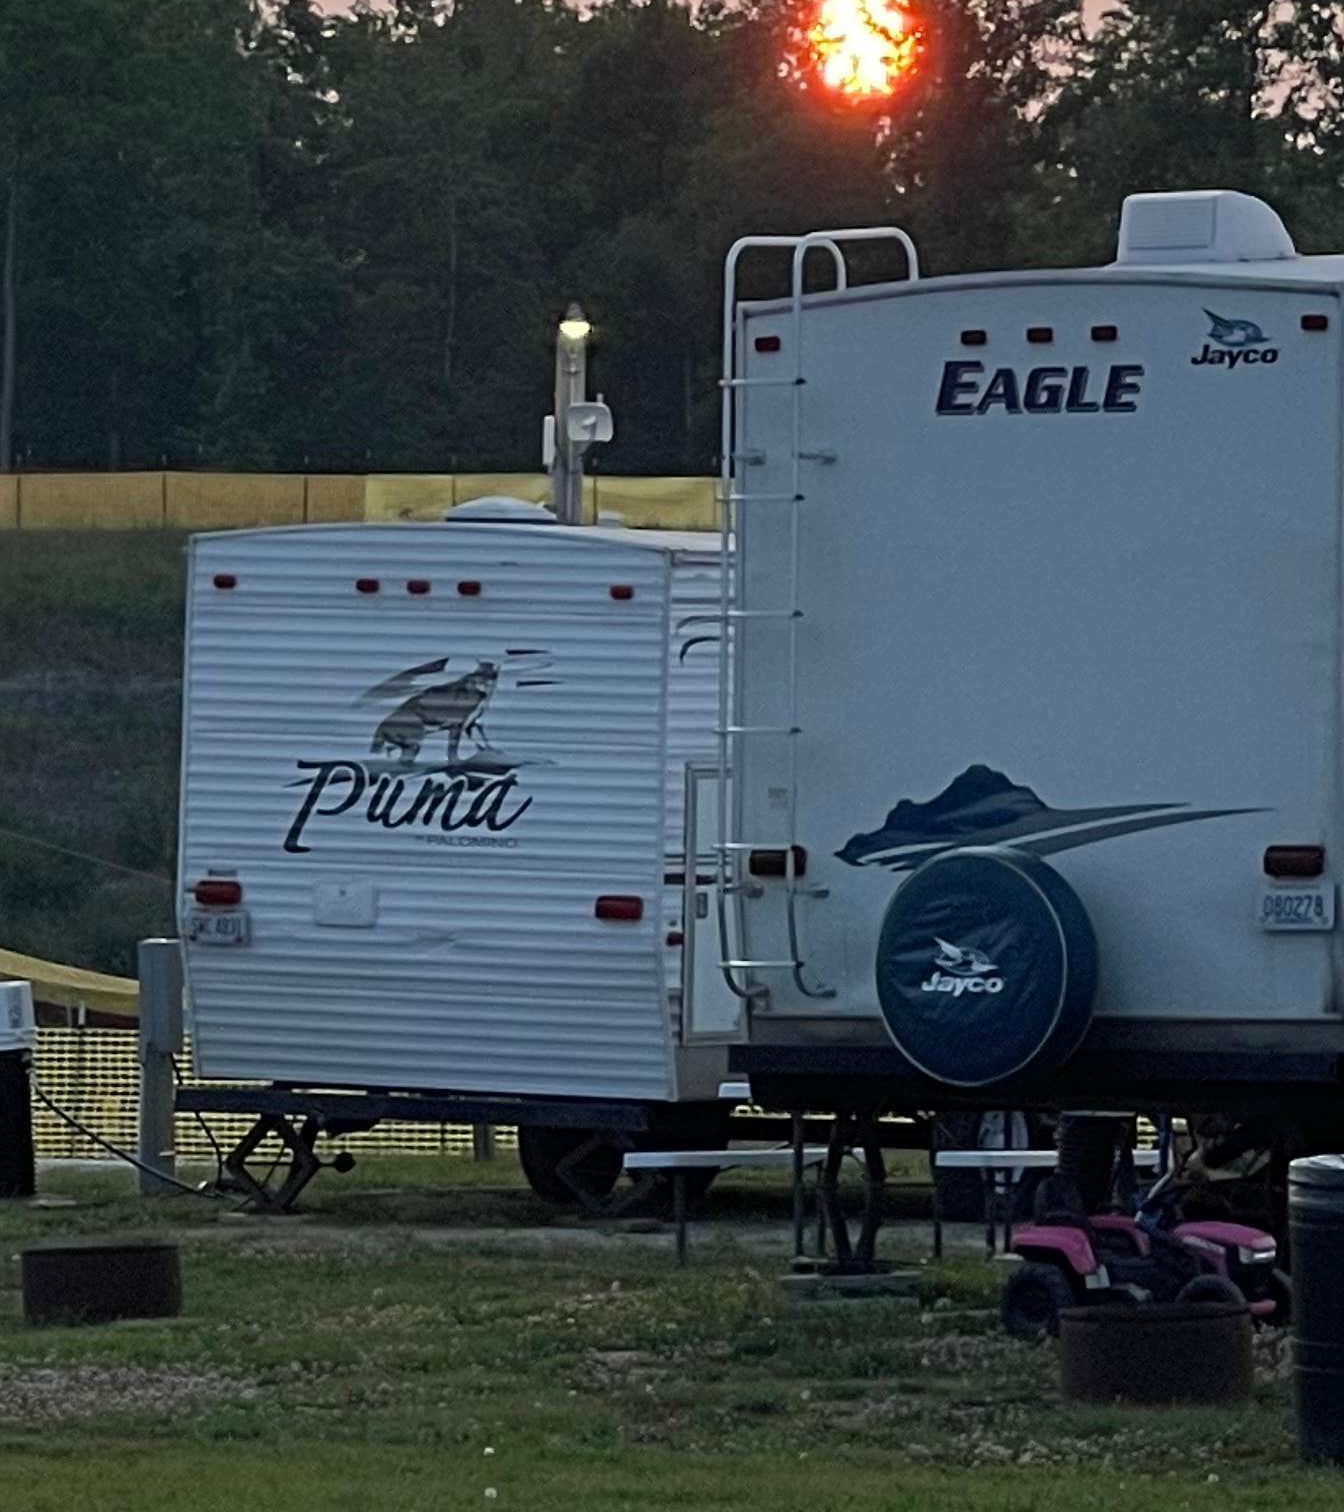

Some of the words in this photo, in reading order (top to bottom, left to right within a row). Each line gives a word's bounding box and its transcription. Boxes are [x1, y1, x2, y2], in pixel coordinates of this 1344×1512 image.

[1190, 344, 1280, 369] Jayco
[935, 360, 1145, 416] EAGLE
[283, 759, 534, 854] Puma
[921, 971, 1004, 997] Jayco
